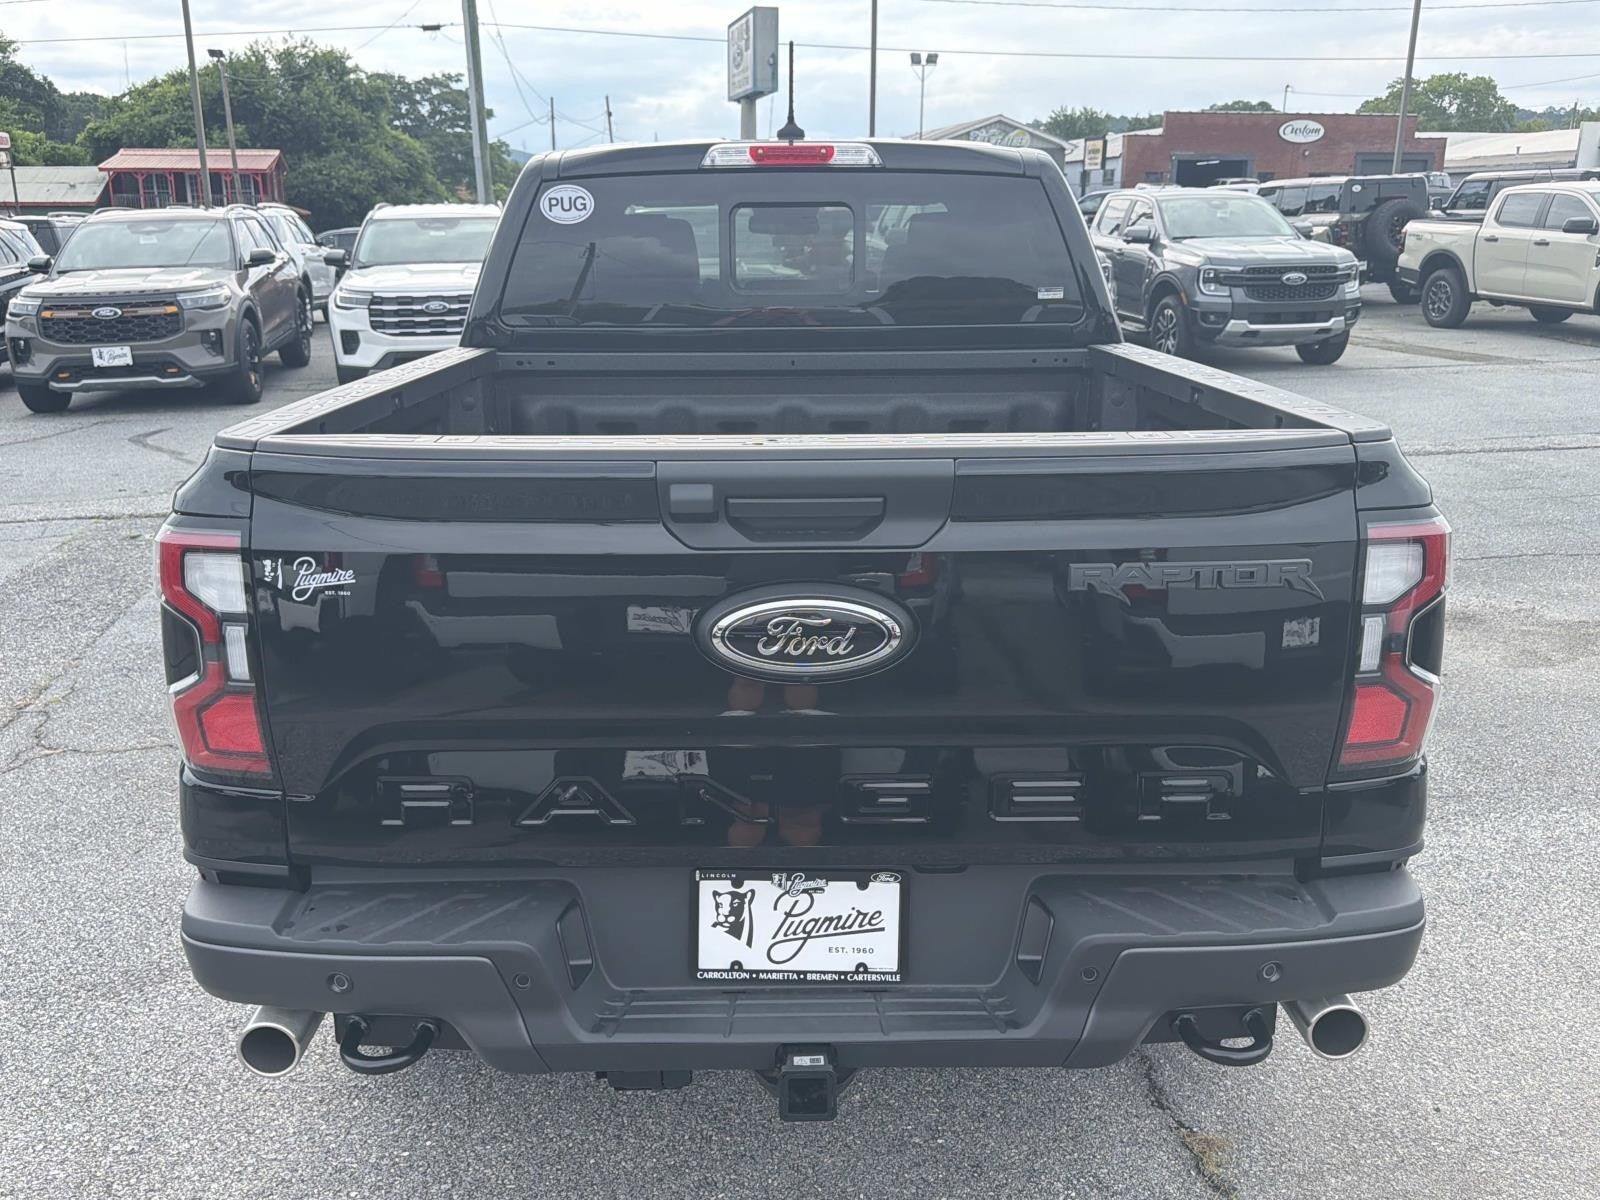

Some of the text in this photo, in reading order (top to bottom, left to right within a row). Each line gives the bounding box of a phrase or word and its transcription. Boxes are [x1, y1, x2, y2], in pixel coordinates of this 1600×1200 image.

[1282, 123, 1321, 138] Custom
[548, 195, 587, 213] PUG
[292, 556, 357, 602] Pugmire
[1068, 558, 1325, 607] RAPTOR
[757, 616, 857, 656] Ford
[378, 768, 1235, 826] RANGER
[766, 891, 885, 965] Pugmire
[828, 946, 875, 955] EST. 1960
[696, 971, 901, 982] CARROLLTON MARIETTA BREMEN CARTERSVILLE
